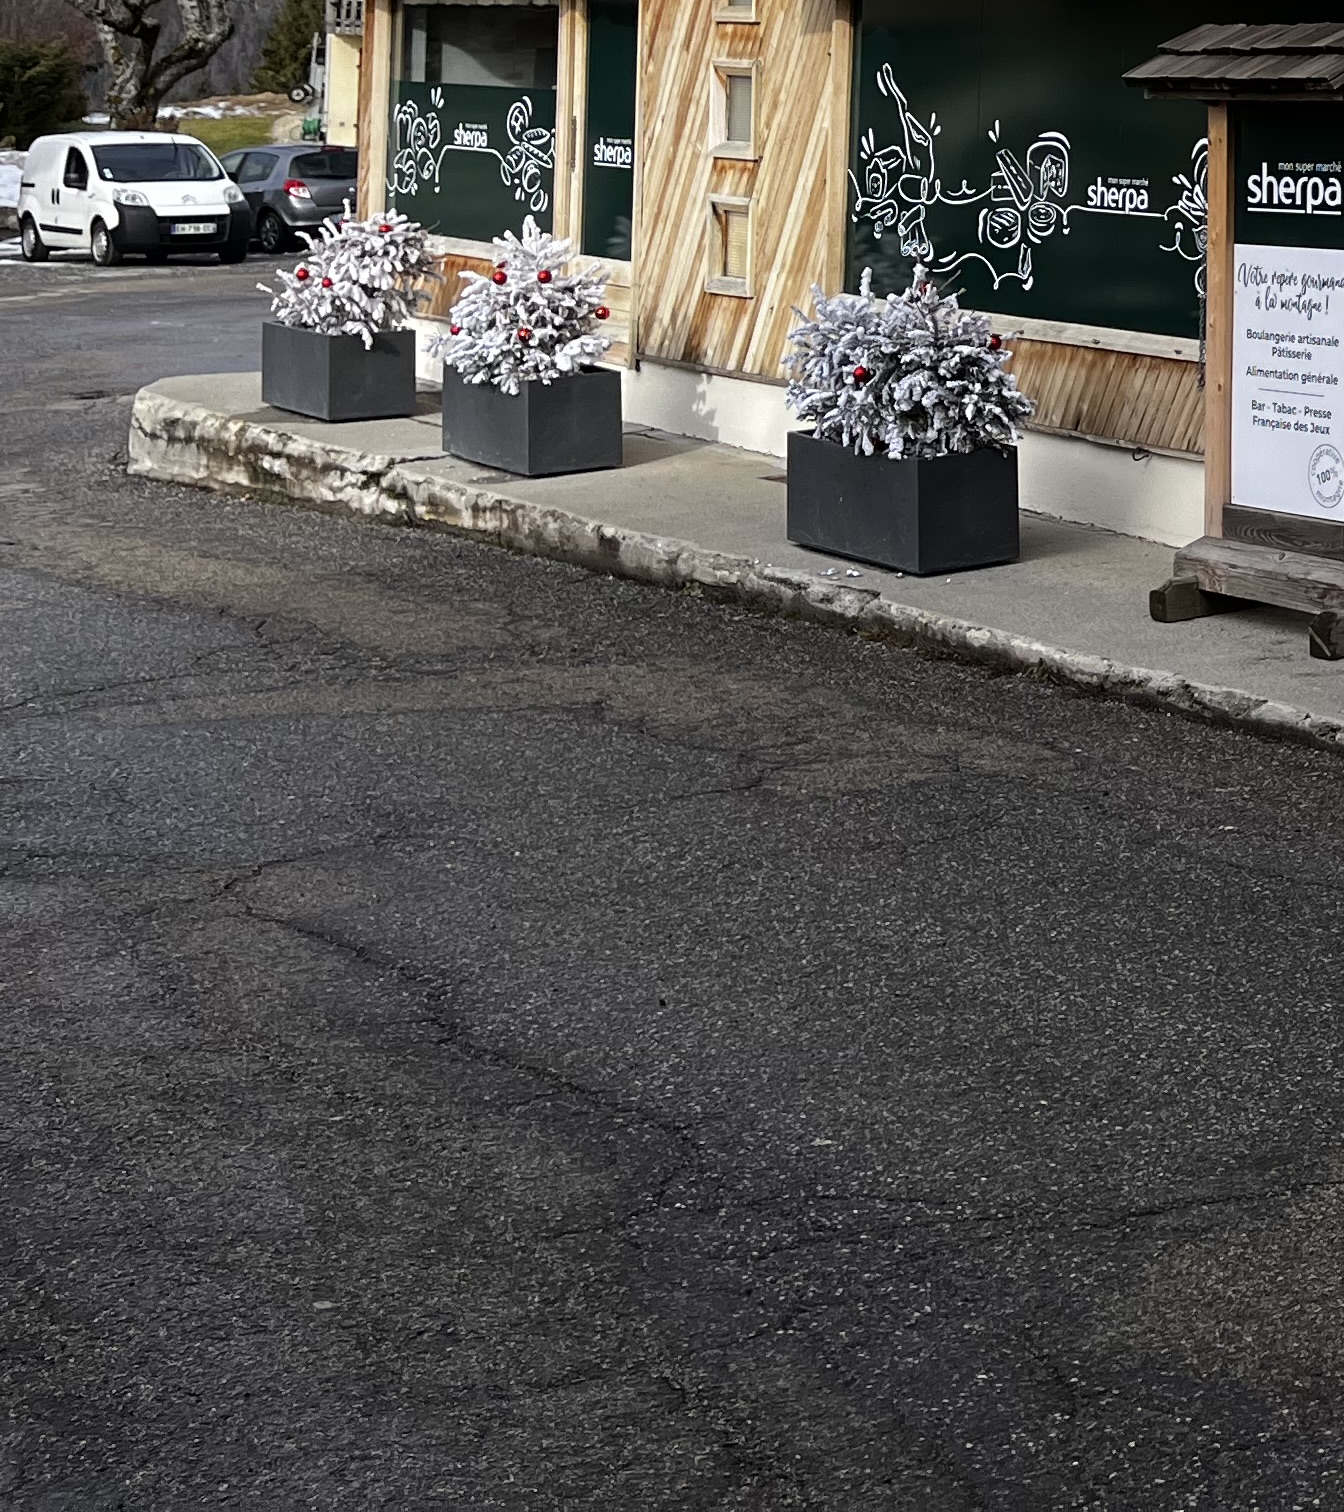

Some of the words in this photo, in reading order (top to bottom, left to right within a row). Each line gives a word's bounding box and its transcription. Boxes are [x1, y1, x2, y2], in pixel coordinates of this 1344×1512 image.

[453, 123, 488, 149] sherpa
[593, 137, 632, 166] sherpa
[1278, 162, 1294, 171] mon
[1295, 163, 1315, 174] super
[1315, 161, 1343, 173] marché
[1087, 177, 1149, 214] sherpa
[1247, 162, 1342, 214] sherpa
[1237, 262, 1268, 288] Votre
[1280, 293, 1323, 320] montagne
[1246, 328, 1296, 344] Boulangerie
[1297, 332, 1340, 347] artisanale
[1271, 346, 1312, 361] Pâtisserie
[1246, 365, 1299, 382] Alimentation
[1301, 371, 1339, 386] générale
[1251, 400, 1265, 411] Bar
[1272, 402, 1297, 415] Tabac
[1304, 405, 1332, 419] Presse
[1252, 415, 1292, 431] Française
[1293, 419, 1309, 432] des
[1310, 421, 1331, 435] Jeux
[1316, 466, 1339, 485] 100%
